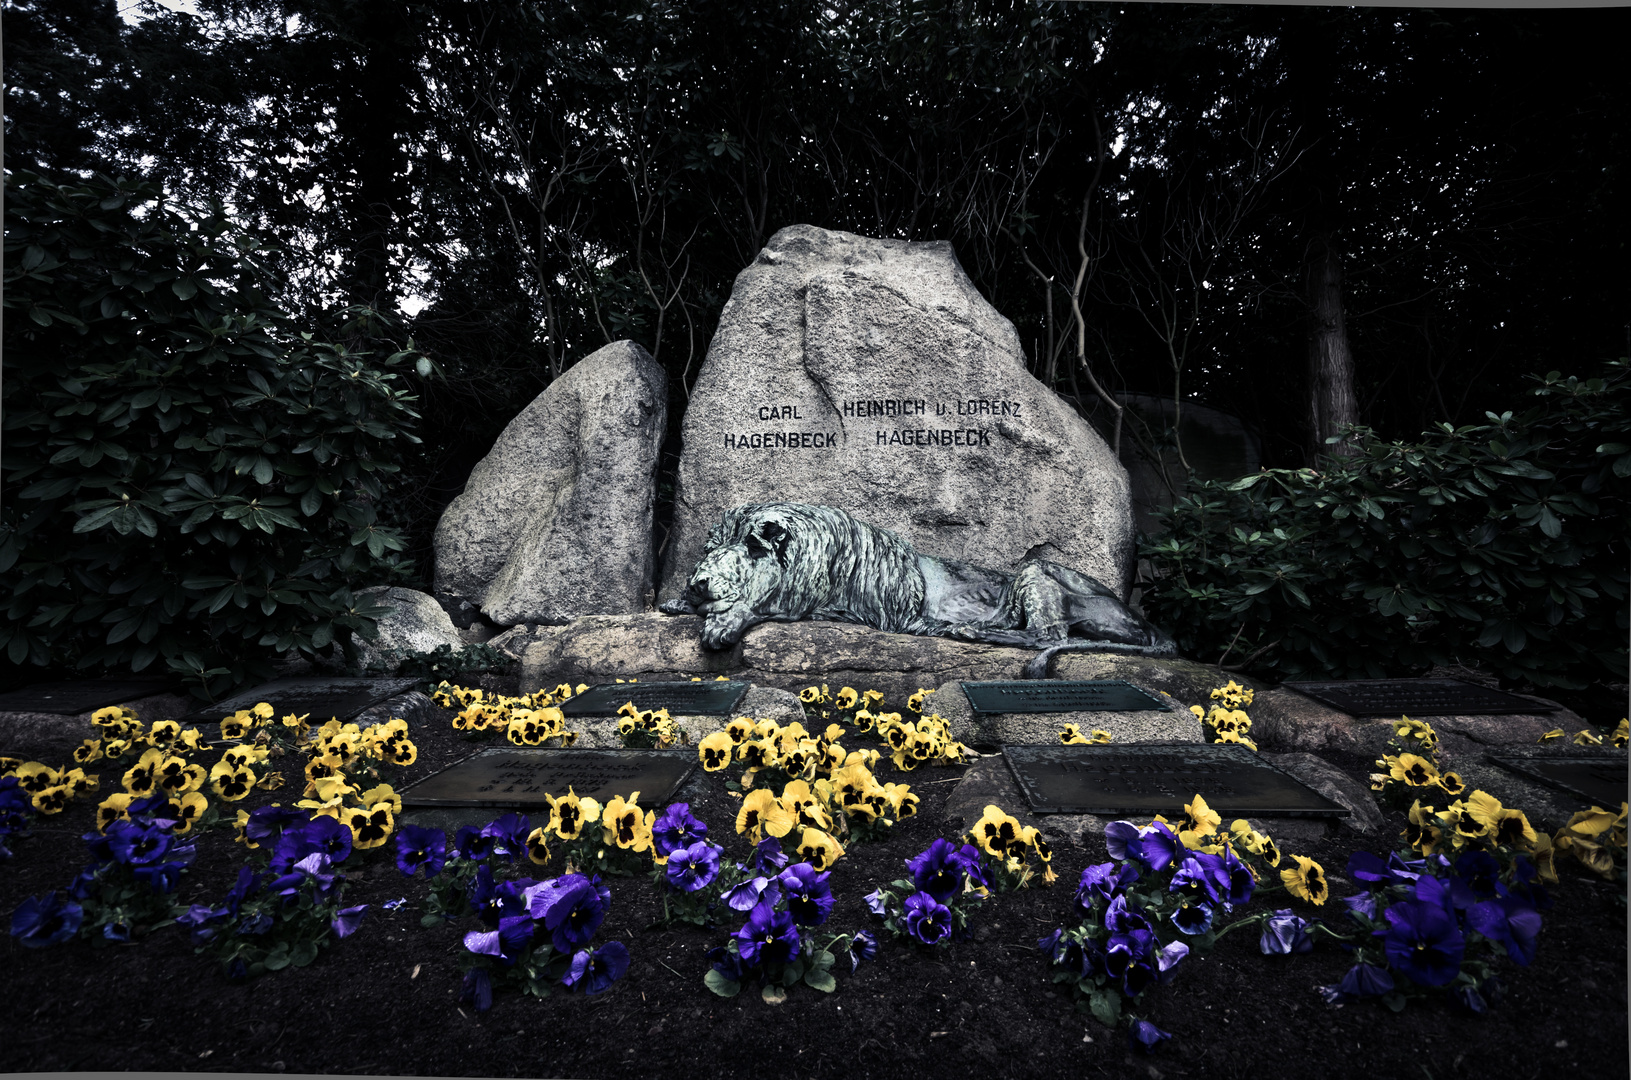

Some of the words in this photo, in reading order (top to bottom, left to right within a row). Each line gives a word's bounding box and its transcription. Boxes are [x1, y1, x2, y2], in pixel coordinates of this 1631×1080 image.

[758, 404, 803, 421] CARL
[843, 399, 926, 418] HEINRICH
[957, 399, 1022, 419] LORENZ
[724, 431, 837, 450] HAGENBECK
[876, 429, 991, 447] HAGENBECK
[1060, 763, 1233, 775] Hagenbeck
